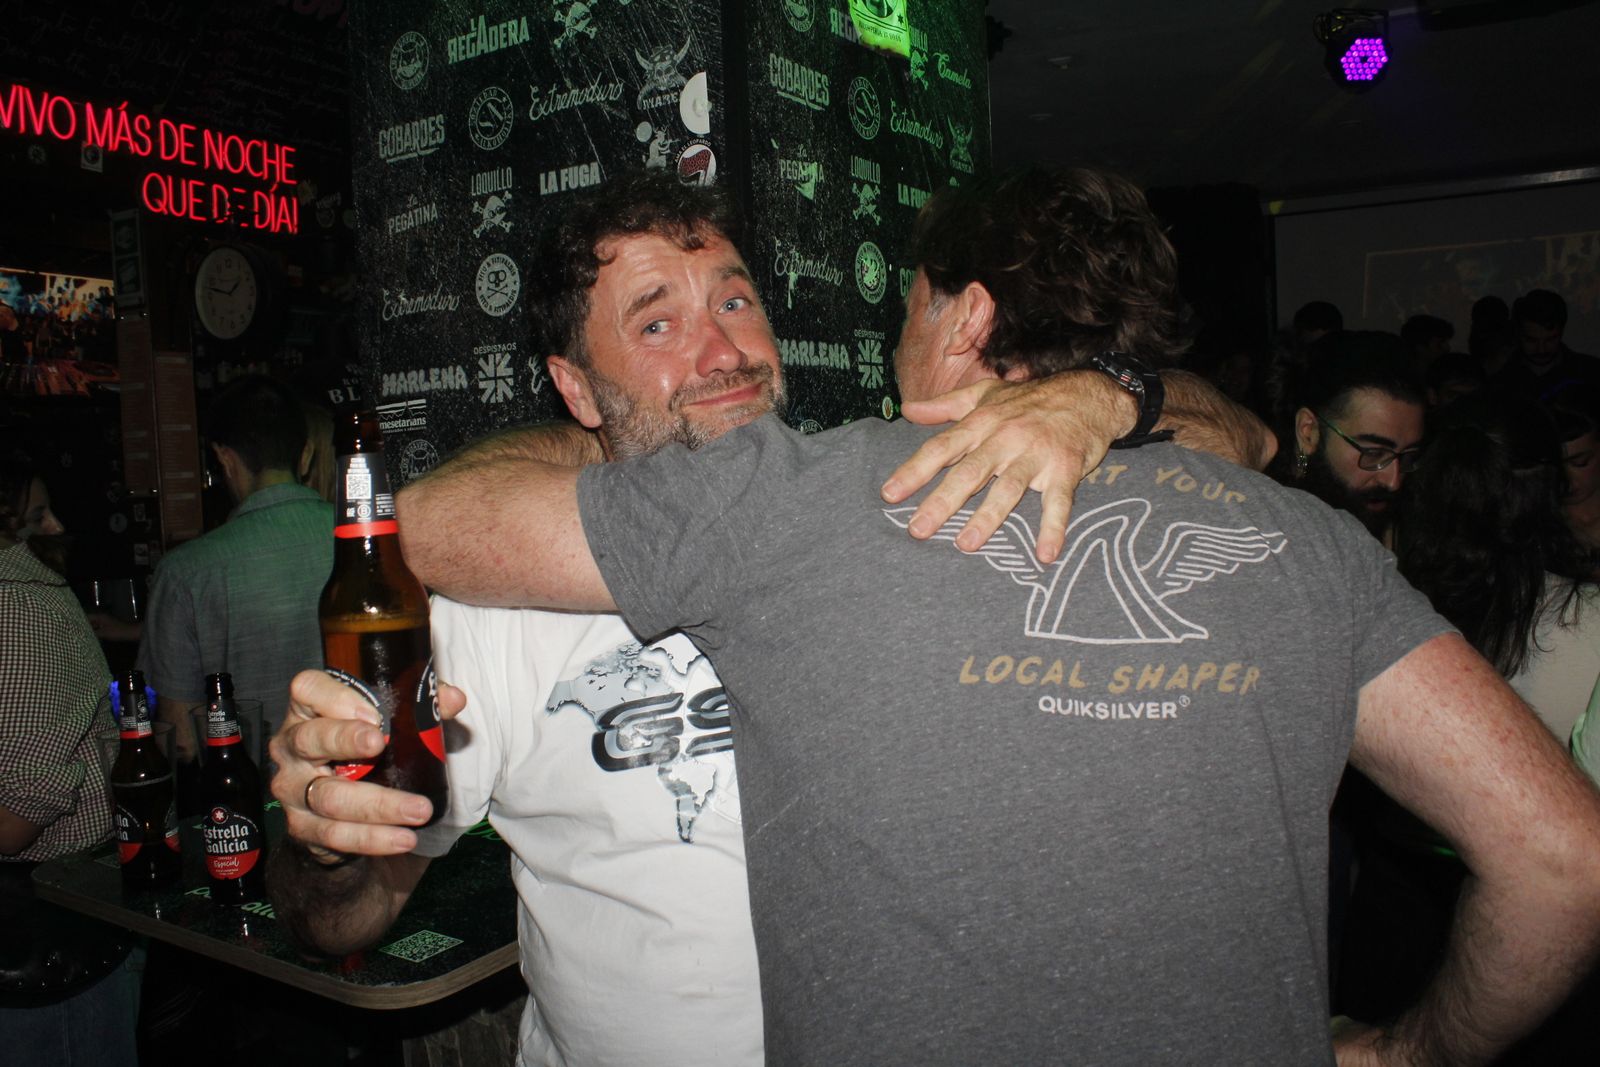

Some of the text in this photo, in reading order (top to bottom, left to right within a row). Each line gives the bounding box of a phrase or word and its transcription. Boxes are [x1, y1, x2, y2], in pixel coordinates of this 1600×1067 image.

[529, 72, 625, 121] Extremoduro
[770, 53, 831, 107] COBARDES
[0, 84, 298, 184] VIVO MÁS DE NOCHE
[379, 113, 446, 160] COBARDES
[890, 97, 944, 150] Extremoduro
[471, 166, 513, 196] LOQUILLO
[539, 161, 601, 195] LA FUGA
[143, 172, 207, 221] QUE
[254, 184, 299, 235] DÍA!
[910, 186, 933, 209] FUG
[388, 202, 439, 235] PEGATINA
[473, 342, 517, 355] DESPISTAOS
[381, 364, 469, 397] MARLENA
[379, 416, 427, 430] mesetarians
[959, 654, 1262, 696] LOCAL SHAPER
[203, 824, 249, 842] Estrella
[204, 838, 249, 854] Galicia
